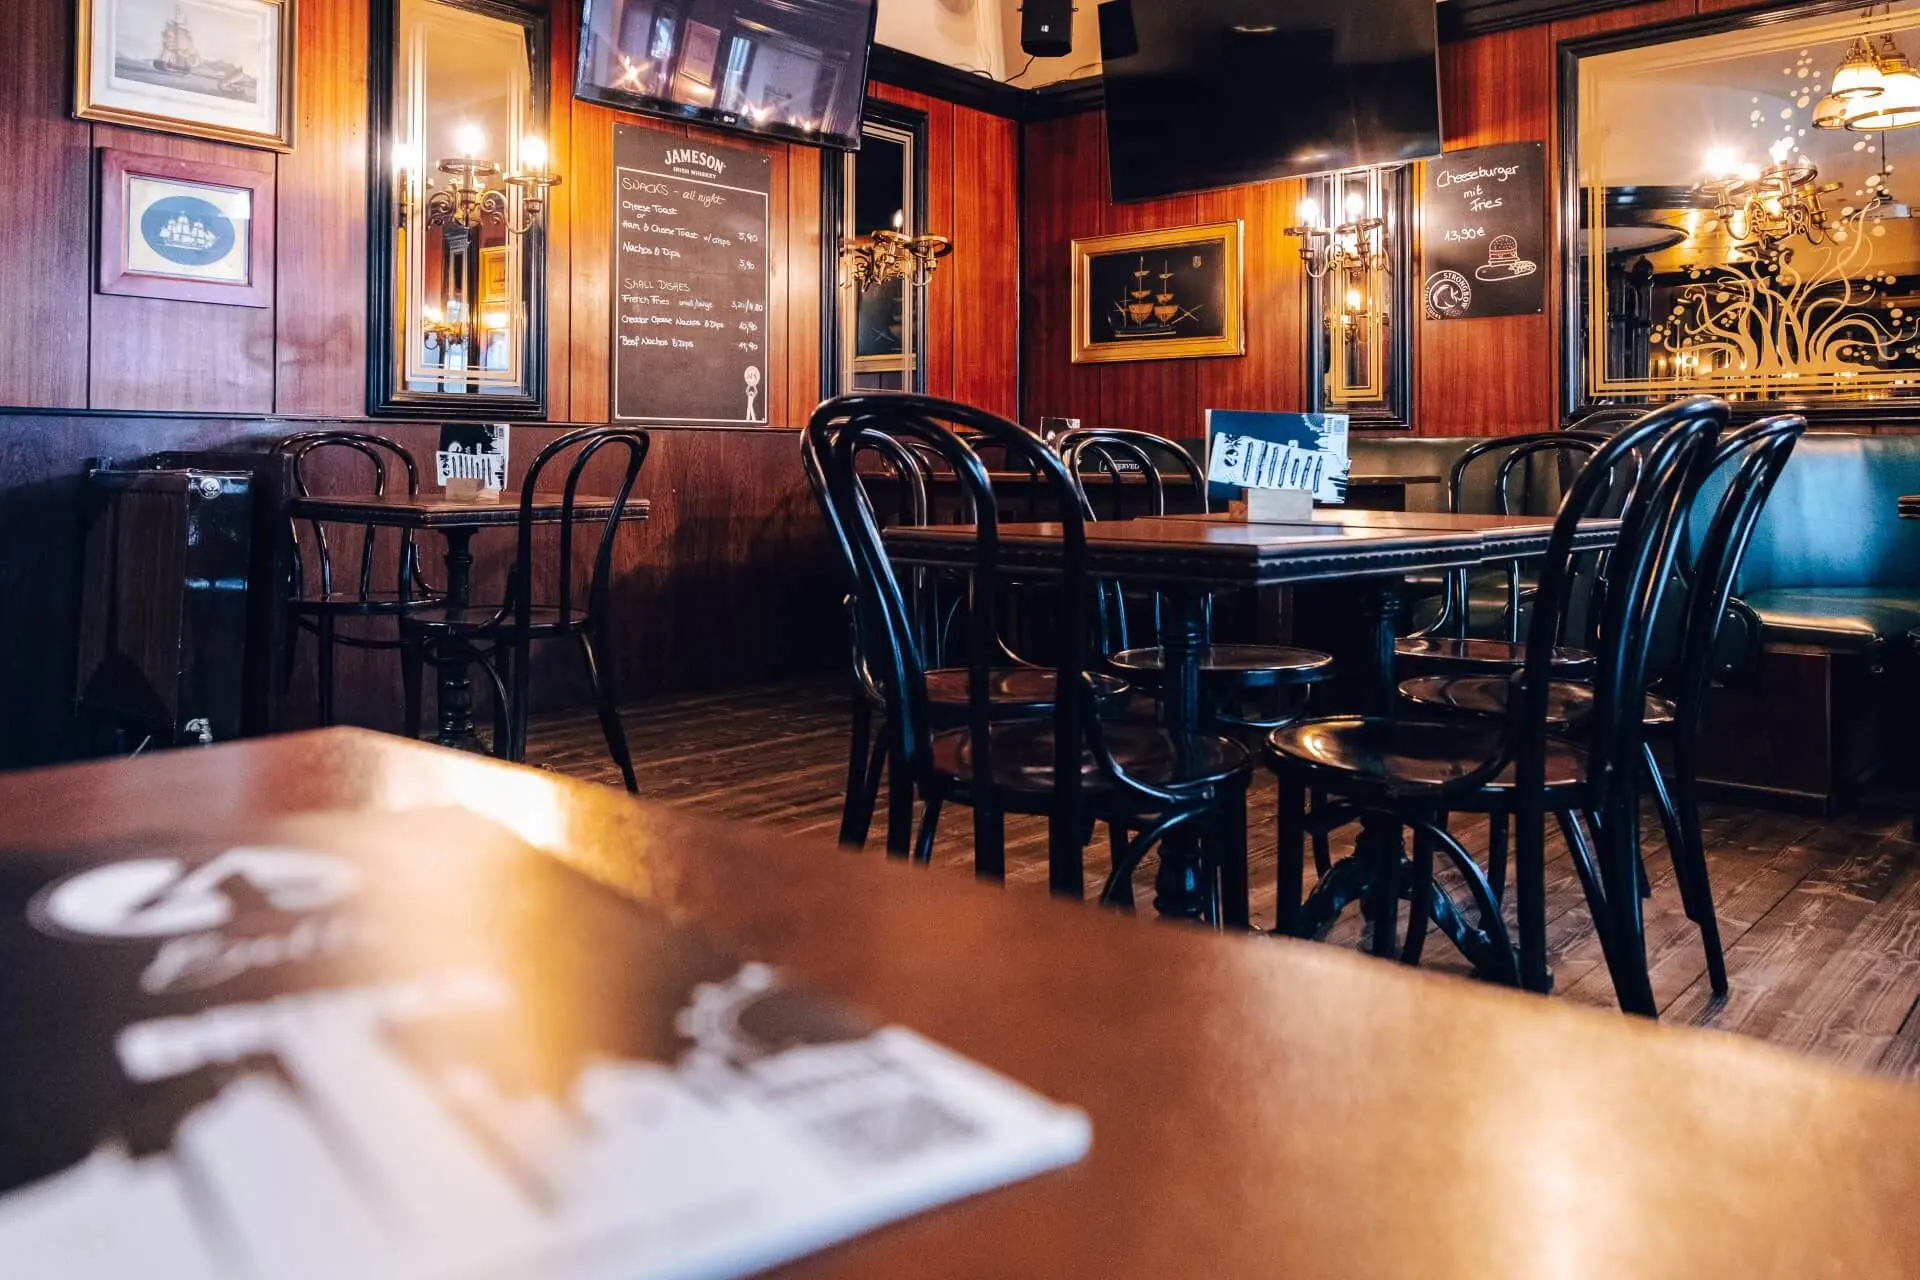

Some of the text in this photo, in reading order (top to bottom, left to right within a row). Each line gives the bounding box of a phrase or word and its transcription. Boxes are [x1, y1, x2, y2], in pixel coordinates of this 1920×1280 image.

[664, 148, 725, 174] JAMESON
[1436, 165, 1519, 188] Cheeseburger
[621, 177, 669, 196] SNACKS
[682, 189, 695, 201] all
[698, 193, 726, 208] night
[1463, 183, 1484, 199] mit
[622, 200, 678, 215] Cheese Toast
[1469, 197, 1503, 212] Fries
[621, 219, 641, 231] Ham
[650, 223, 675, 236] Cheese
[675, 227, 699, 239] Toast
[622, 240, 652, 255] Nachos
[661, 247, 681, 259] Dips
[624, 278, 690, 292] SMALL DISHES
[621, 294, 649, 305] French
[650, 295, 670, 305] Fries
[675, 317, 701, 327] Nachos
[619, 335, 640, 347] Beef
[641, 336, 668, 346] Nachos
